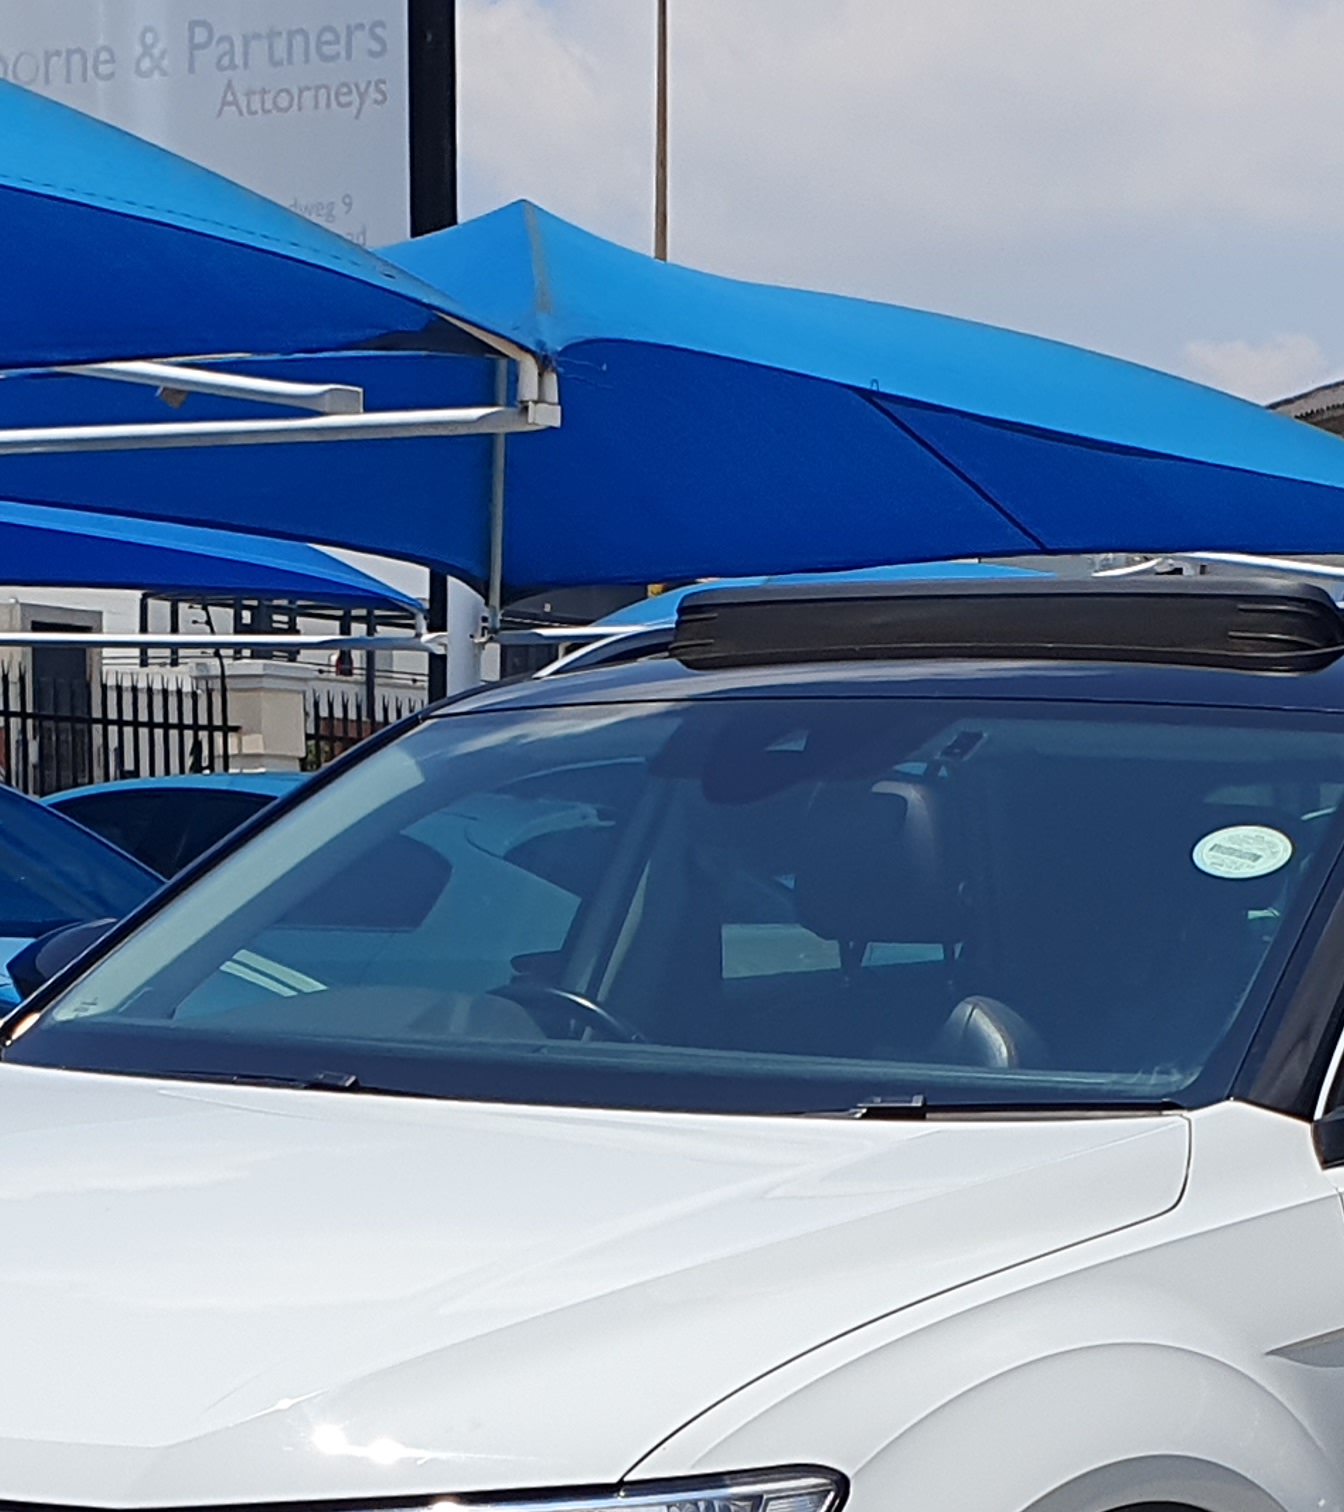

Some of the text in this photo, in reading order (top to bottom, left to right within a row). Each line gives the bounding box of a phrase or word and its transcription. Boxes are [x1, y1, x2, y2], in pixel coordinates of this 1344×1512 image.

[134, 25, 169, 79] &
[187, 19, 389, 75] Partners
[216, 78, 389, 120] Attorneys
[341, 193, 354, 215] 9
